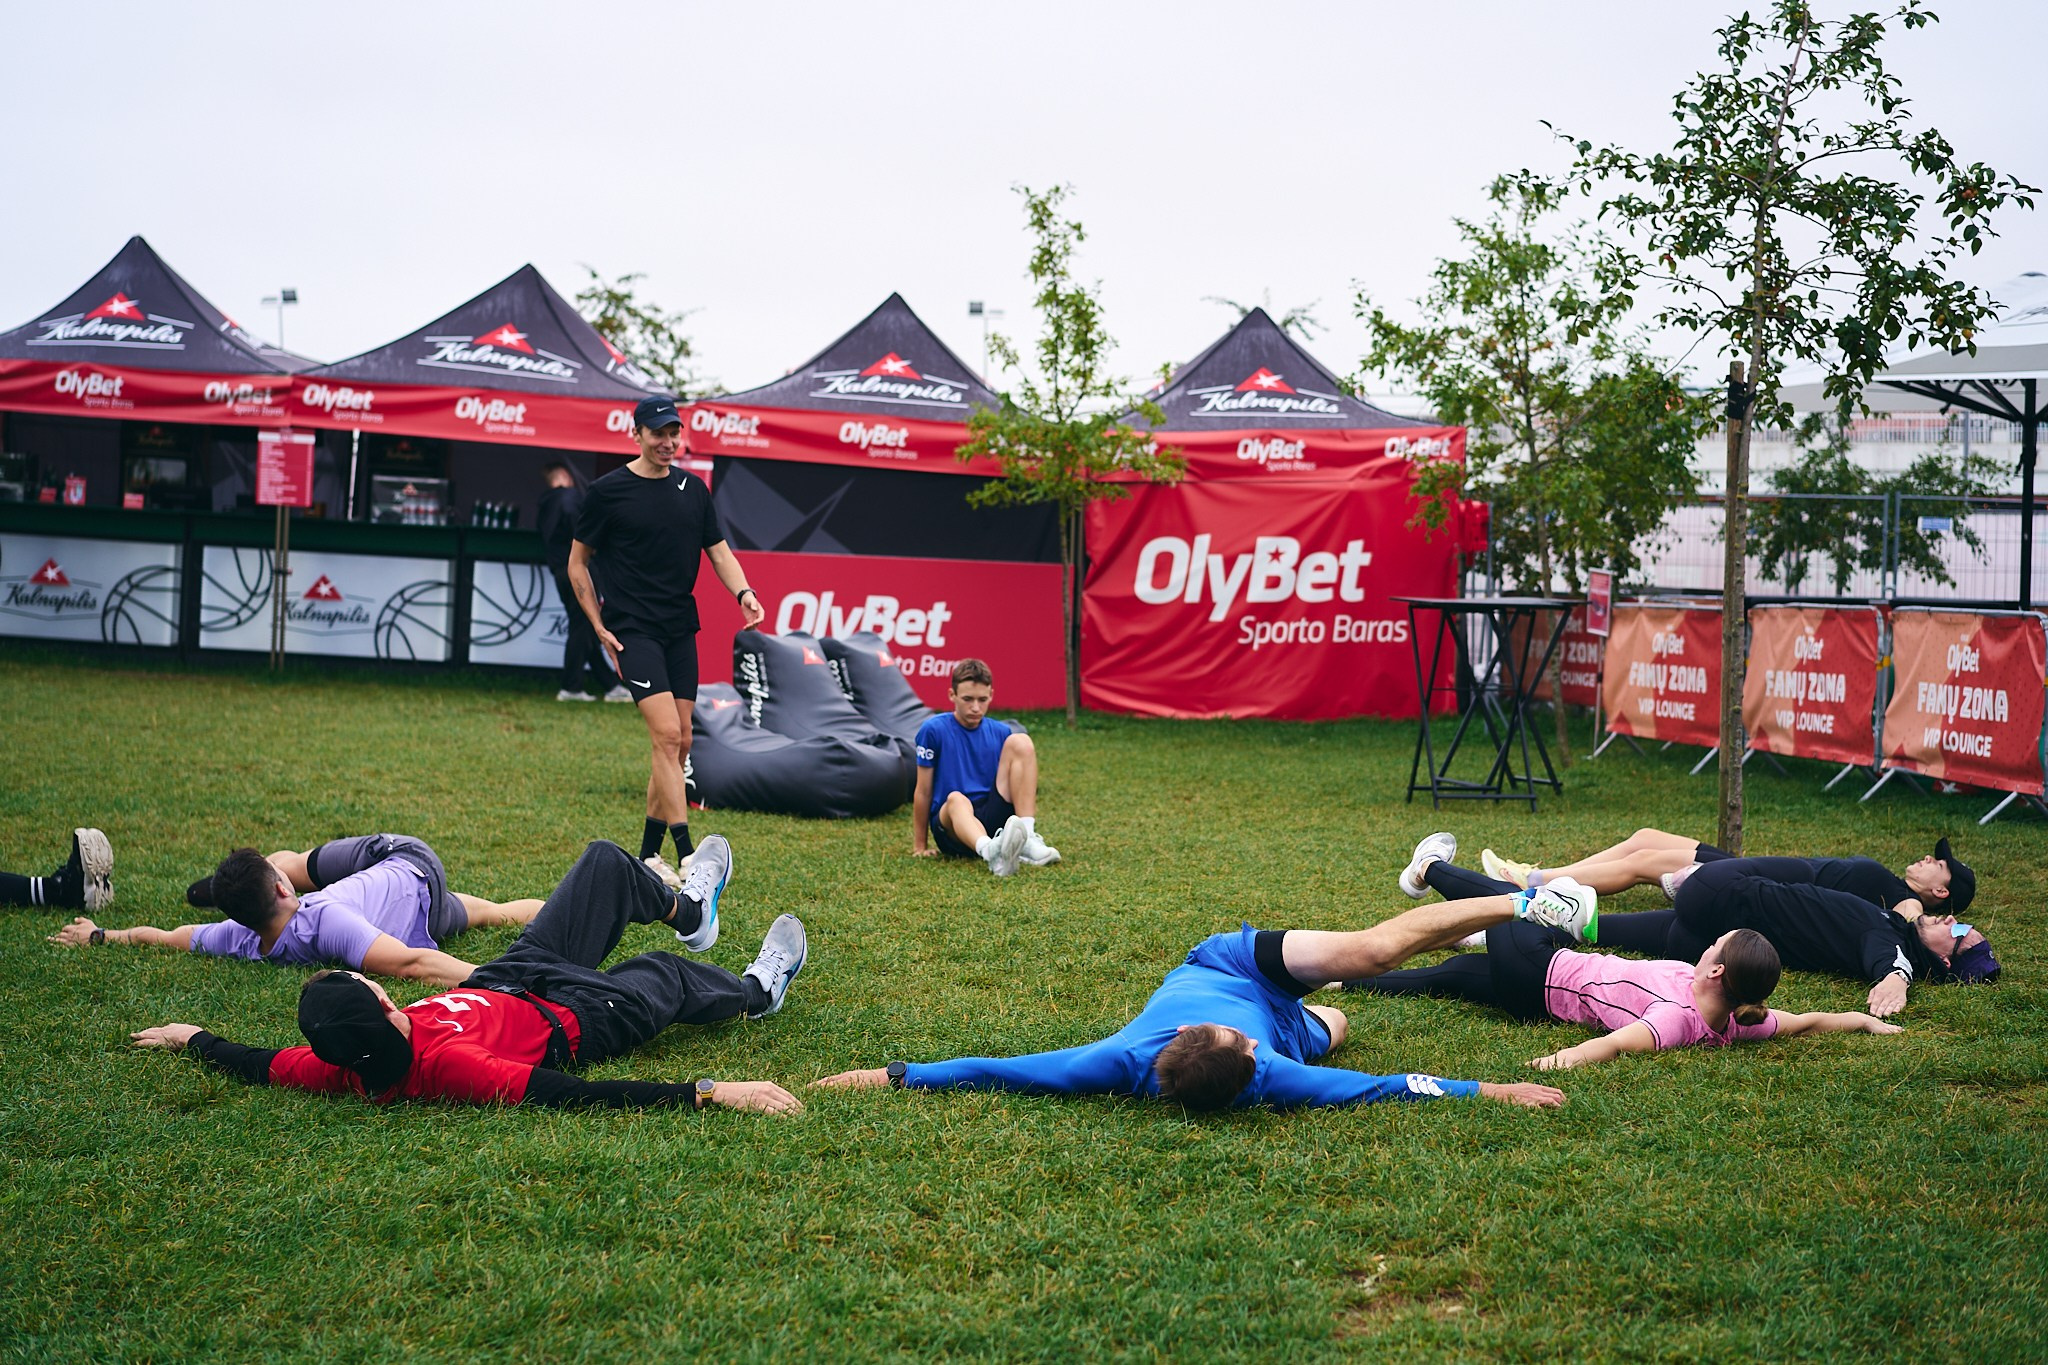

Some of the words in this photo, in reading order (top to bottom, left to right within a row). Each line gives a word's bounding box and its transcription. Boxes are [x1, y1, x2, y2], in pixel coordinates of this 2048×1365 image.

[41, 317, 184, 344] Kalnapilis
[429, 342, 574, 378] Kalnapilis
[54, 370, 124, 399] OlyBet
[204, 381, 273, 408] OlyBet
[302, 383, 375, 413] OlyBet
[821, 375, 962, 404] Kalnapilis
[454, 396, 527, 425] OlyBet
[1200, 390, 1339, 414] Kalnapilis
[691, 409, 761, 438] OlyBet
[838, 421, 910, 450] OlyBet
[1236, 437, 1306, 465] OlyBet
[1384, 436, 1451, 462] OlyBet
[1133, 533, 1372, 622] OlyBet
[4, 582, 97, 614] Kalnapilis
[775, 591, 952, 648] OlyBet
[1238, 615, 1325, 651] Sporto
[1332, 614, 1408, 643] Baras
[1567, 642, 1605, 665] ZON
[1652, 632, 1685, 659] OlyBet
[1794, 635, 1824, 665] OlyBet
[1947, 644, 1980, 678] OlyBet
[1560, 670, 1596, 688] OUNGE
[1668, 665, 1707, 694] ZONA
[1808, 672, 1846, 703] ZONA
[1638, 698, 1655, 714] VIP
[1656, 700, 1695, 721] LOUNGE
[1960, 686, 2008, 723] ZONA
[1776, 710, 1795, 728] VIP
[1796, 711, 1834, 734] LOUNGE
[1923, 727, 1941, 748] VIP
[1943, 729, 1992, 757] LOUNGE
